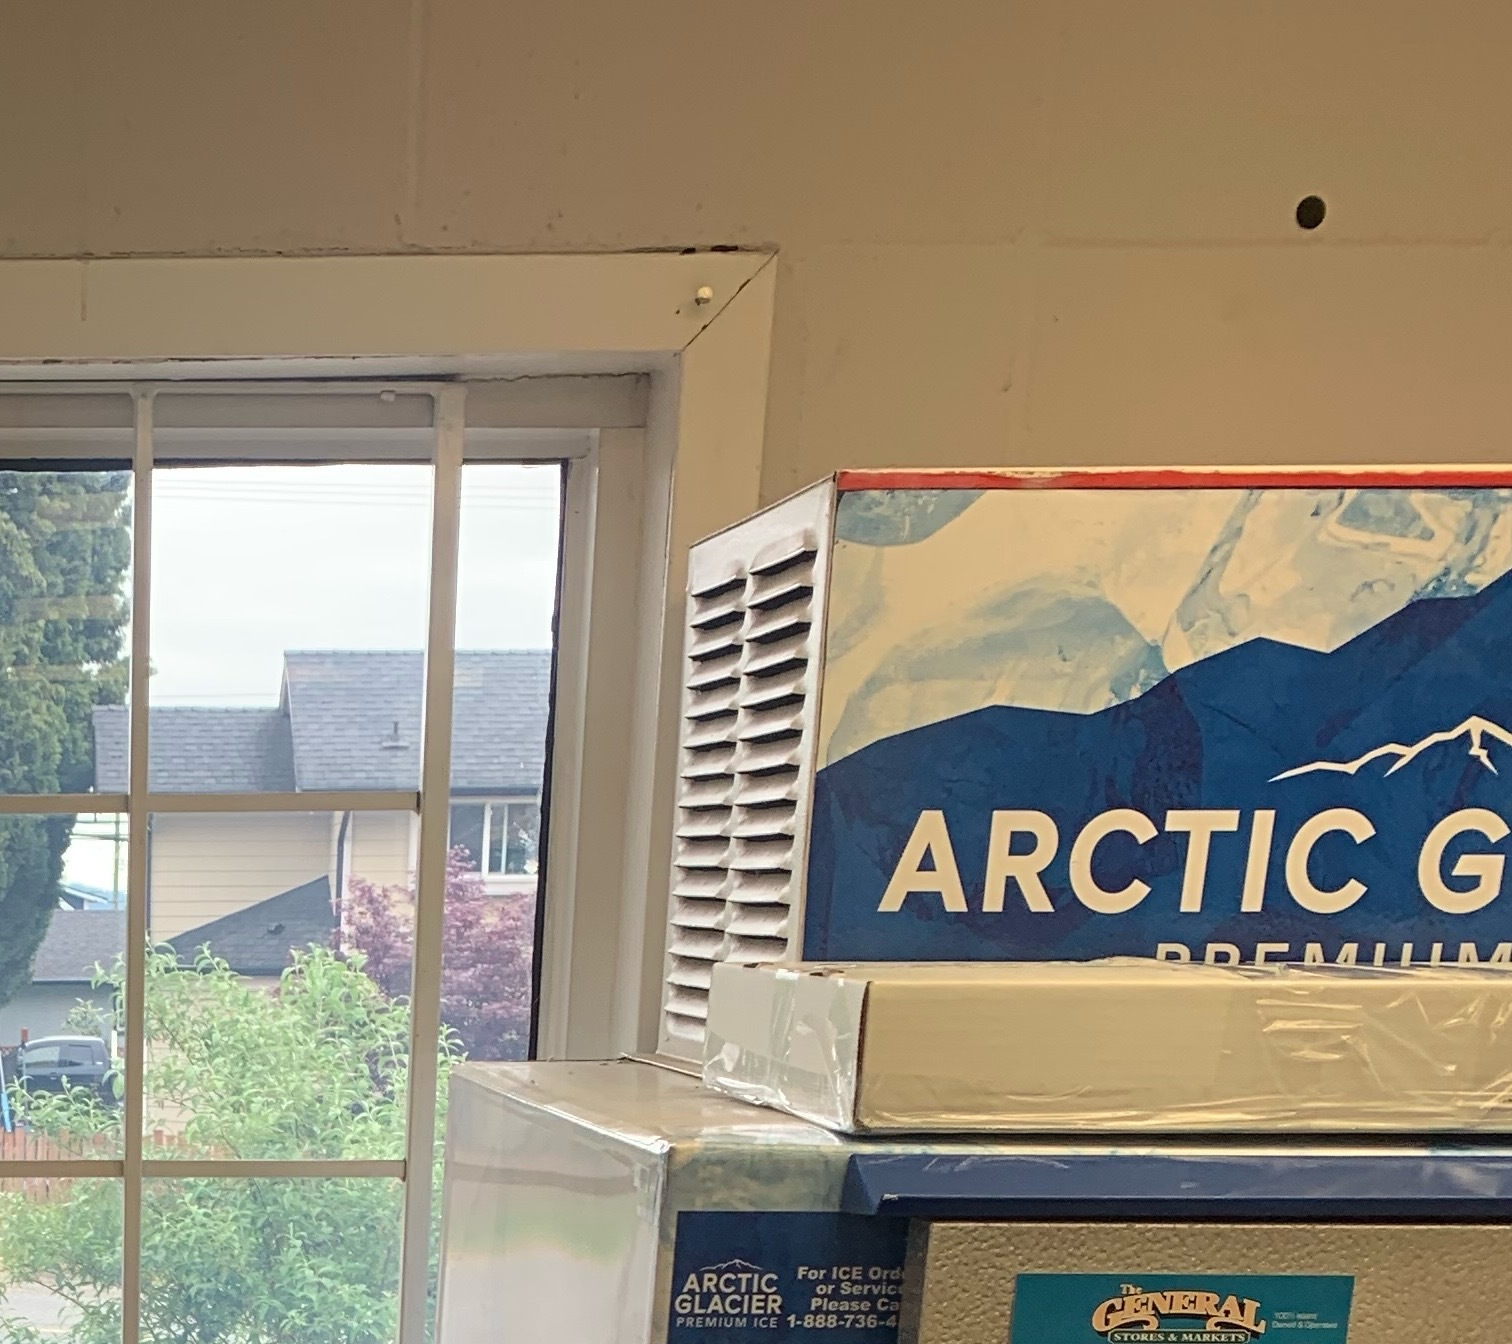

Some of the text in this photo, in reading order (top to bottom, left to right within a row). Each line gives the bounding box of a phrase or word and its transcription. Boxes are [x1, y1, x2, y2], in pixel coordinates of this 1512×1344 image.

[877, 807, 1378, 914] ARCTIC
[797, 1265, 828, 1280] For
[832, 1266, 863, 1280] ICE
[683, 1272, 779, 1293] ARCTIC
[816, 1284, 835, 1295] or
[1119, 1283, 1143, 1296] The
[674, 1294, 783, 1315] GLACIER
[810, 1297, 871, 1312] Please
[1091, 1290, 1267, 1336] GENERAL
[676, 1317, 778, 1328] PREMIUM ICE
[1113, 1331, 1246, 1343] STORES & MARKETS
